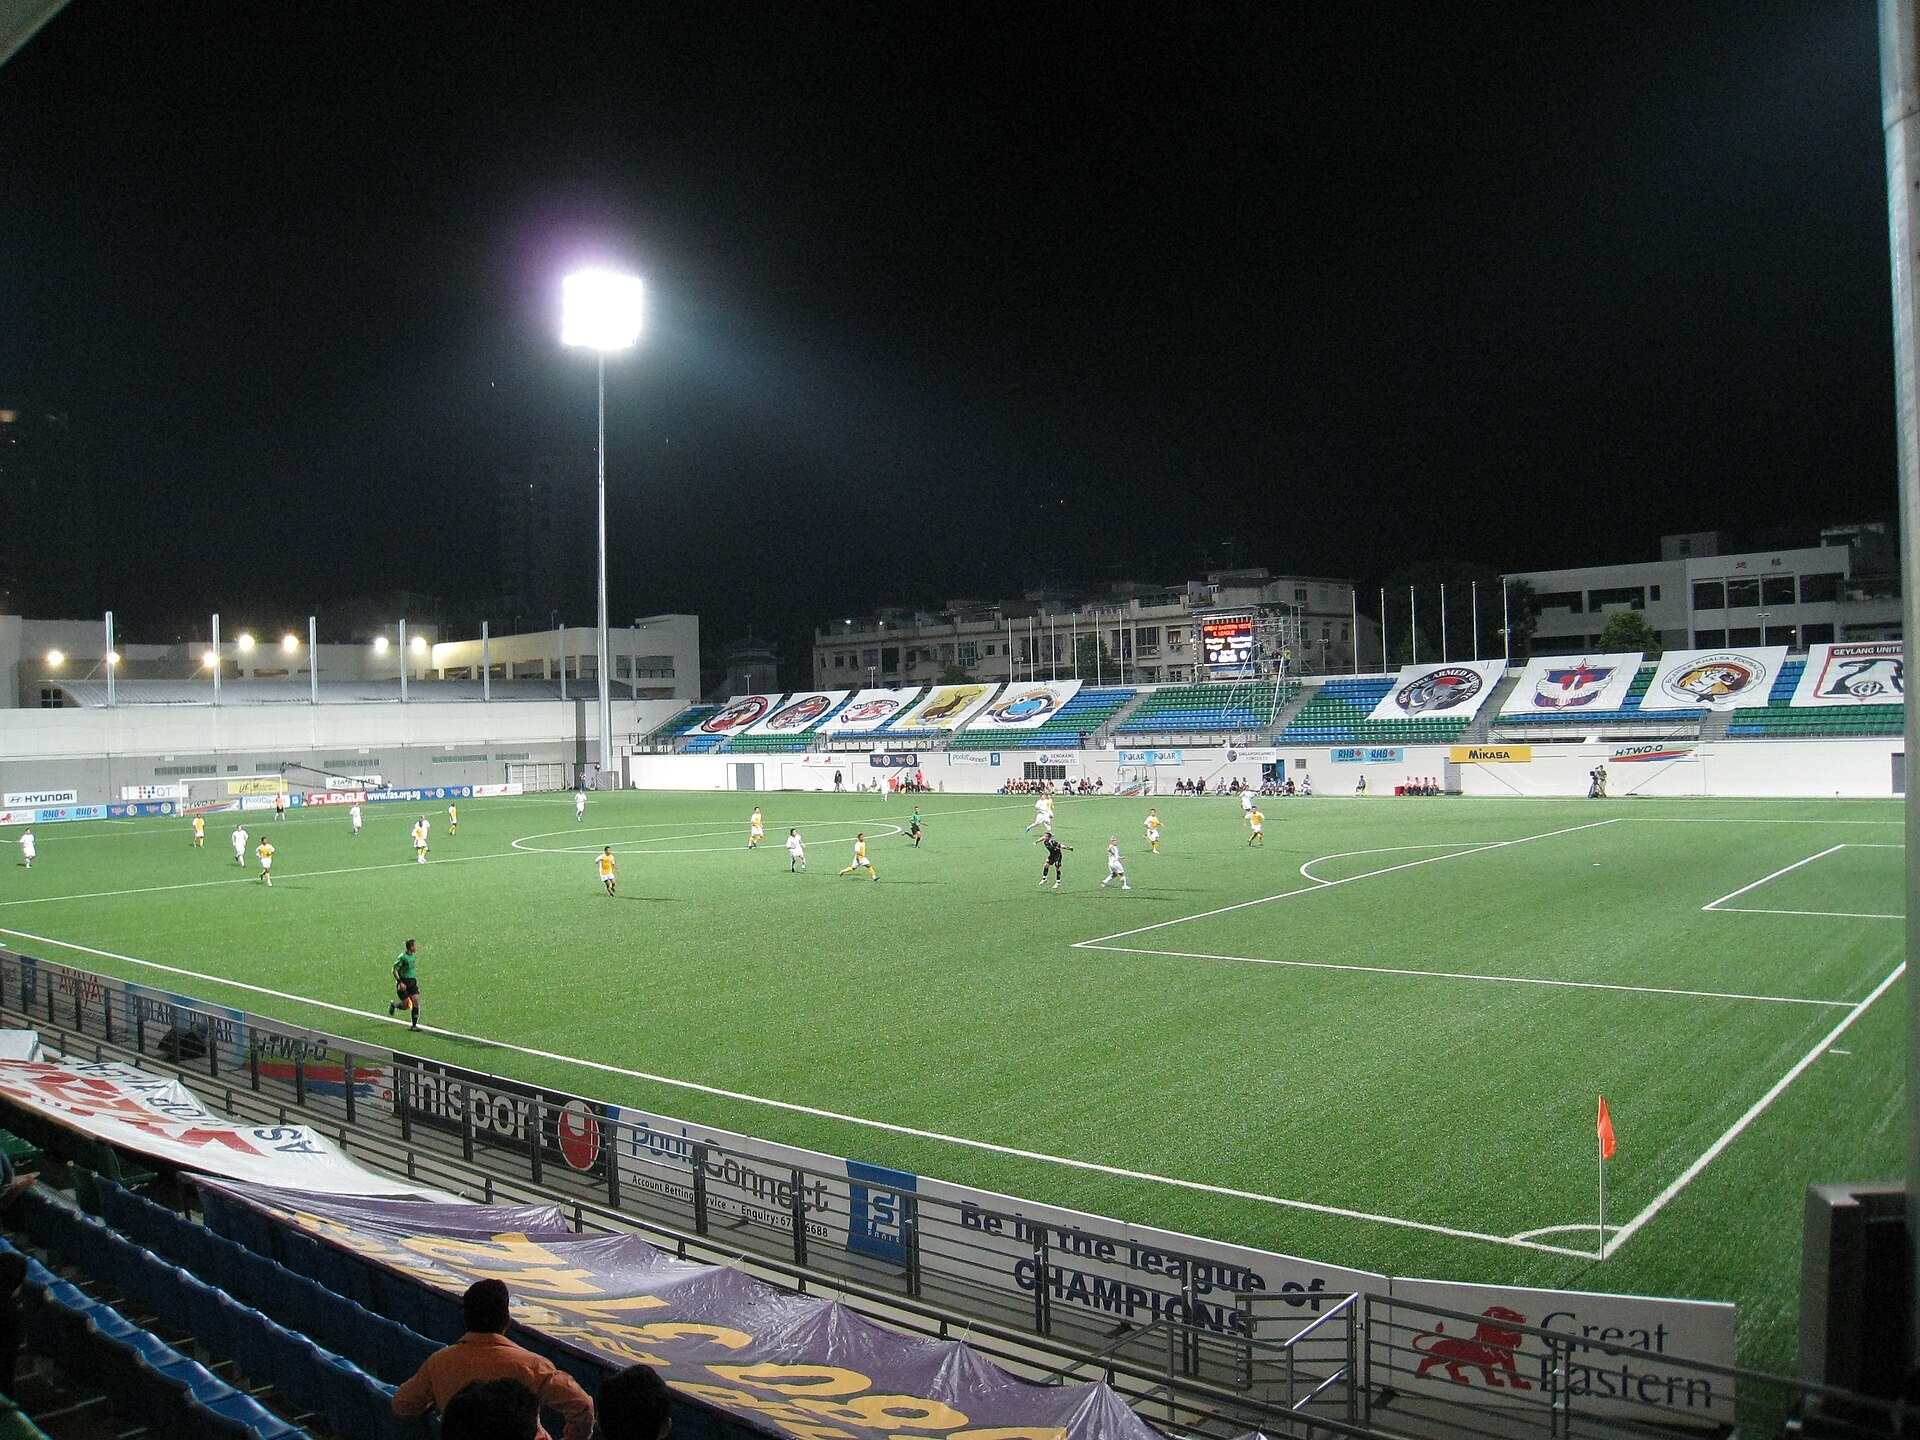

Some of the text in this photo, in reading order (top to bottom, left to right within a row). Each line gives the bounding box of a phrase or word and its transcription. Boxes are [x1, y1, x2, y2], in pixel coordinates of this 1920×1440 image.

[1833, 645, 1903, 656] GEYLANG UNITE
[1432, 669, 1468, 680] ARMED
[1123, 752, 1145, 761] POLAR
[1153, 752, 1176, 760] POLAR
[1337, 749, 1354, 759] RHB
[1371, 749, 1388, 759] RHB
[157, 787, 173, 797] QT
[367, 789, 421, 801] www.fas.org.sg
[25, 793, 73, 803] HYUNDAI
[42, 810, 60, 819] RHB
[75, 808, 92, 817] RHB
[189, 1011, 233, 1043] POAR
[632, 1175, 727, 1210] Account Betting rvice
[741, 1204, 828, 1238] Enquiry: 676688
[961, 1200, 1003, 1235] Be
[1057, 1225, 1116, 1264] the
[1129, 1238, 1266, 1295] league
[1282, 1277, 1325, 1312] of
[1014, 1259, 1253, 1339] CHAMPIONS
[1540, 1311, 1669, 1356] Great
[1539, 1353, 1712, 1409] Eastern
